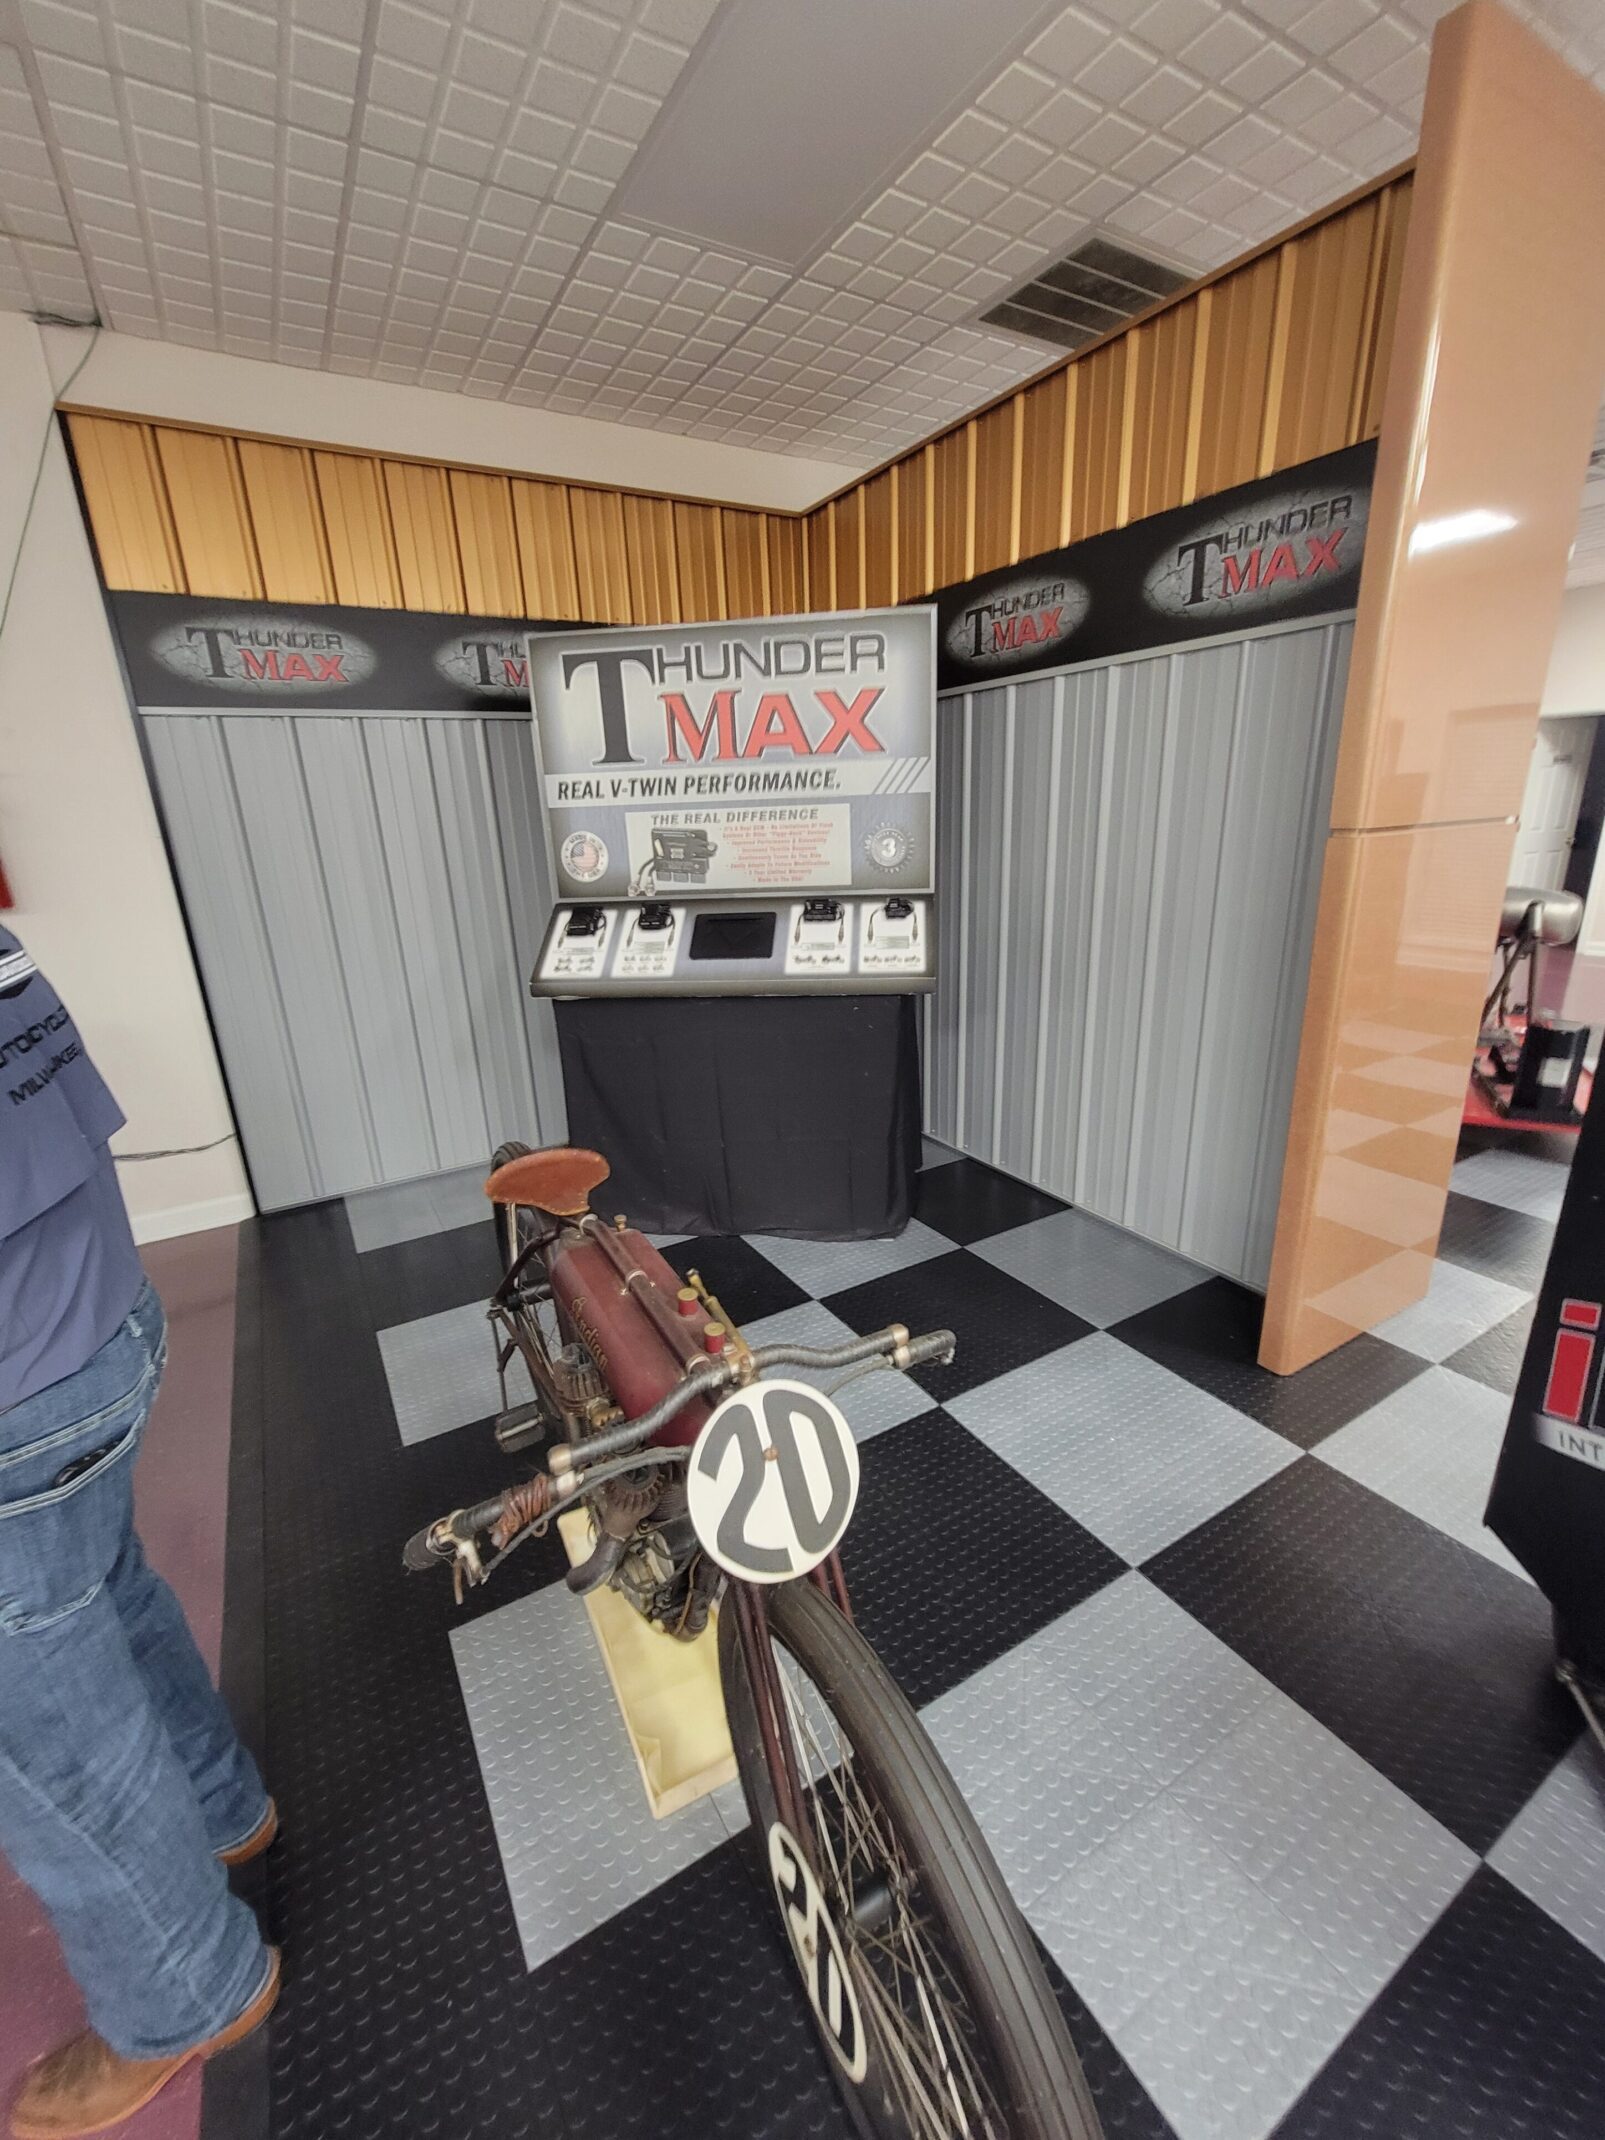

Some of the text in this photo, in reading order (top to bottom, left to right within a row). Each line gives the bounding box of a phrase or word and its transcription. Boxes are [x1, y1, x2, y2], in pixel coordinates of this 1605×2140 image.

[1177, 494, 1353, 607] THUNDER
[1219, 527, 1350, 600] MAX
[185, 627, 344, 679] THUNDER
[965, 582, 1065, 658] THUNDER
[991, 606, 1064, 653] MAX
[238, 648, 350, 683] MAX
[562, 633, 886, 766] THUNDER
[658, 687, 887, 765] MAX
[558, 768, 841, 801] REAL V-TWIN PERFORMANCE.
[651, 808, 819, 826] THE REAL DIFFERENCE
[697, 1389, 852, 1574] 20
